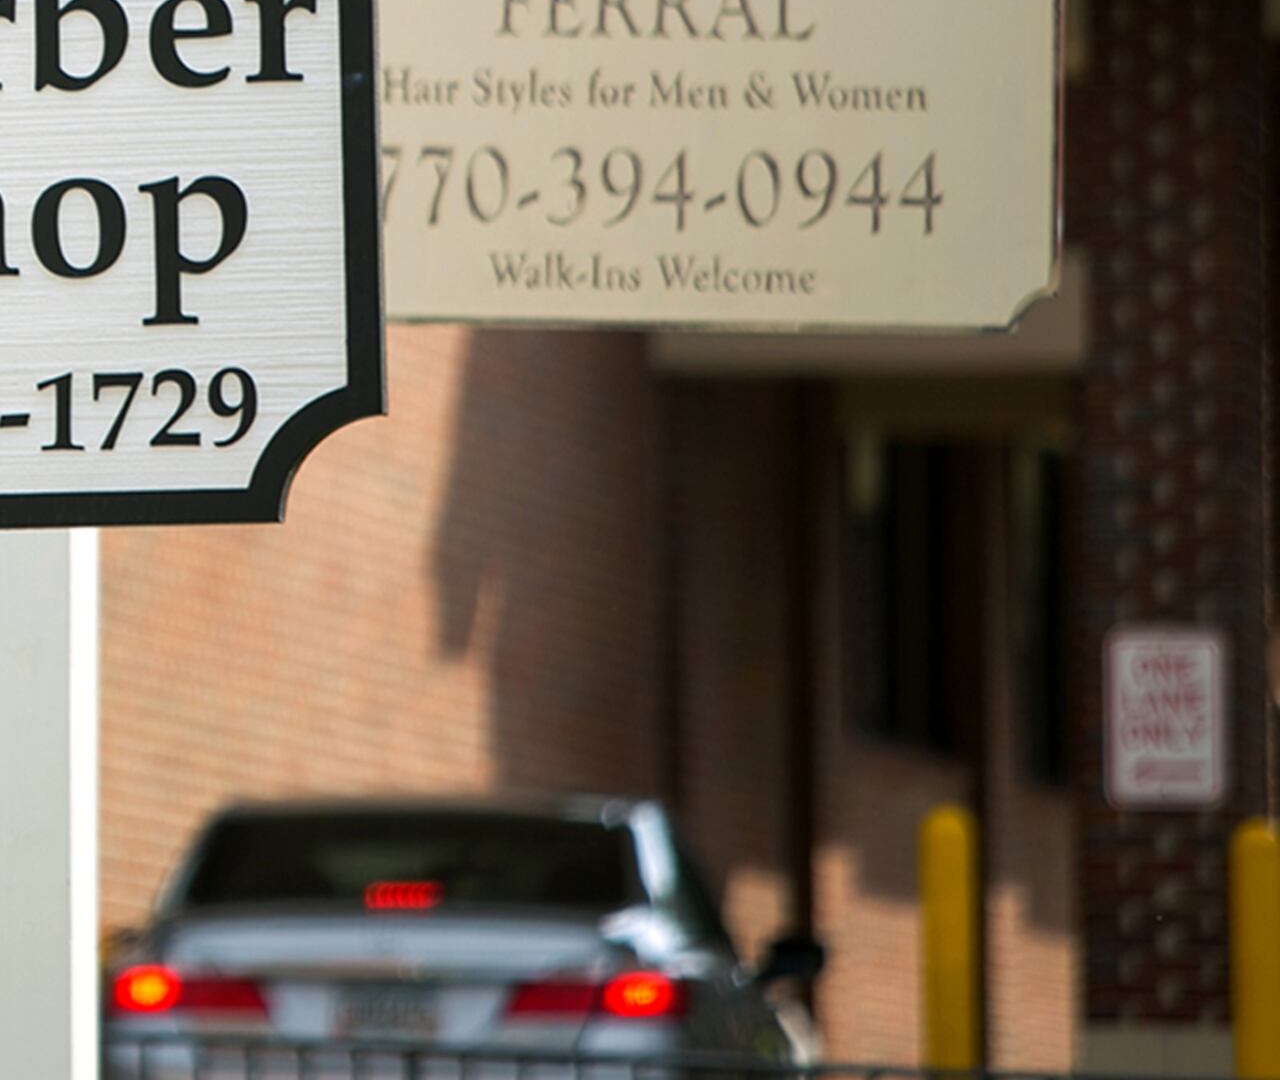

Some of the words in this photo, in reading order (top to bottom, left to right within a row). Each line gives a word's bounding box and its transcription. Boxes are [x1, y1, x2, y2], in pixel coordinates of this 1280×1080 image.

[382, 68, 458, 107] Hair
[471, 68, 572, 113] Styles
[586, 68, 637, 107] for
[648, 72, 729, 110] Men
[745, 73, 775, 110] &
[789, 70, 929, 113] Women
[380, 144, 944, 236] 770-394-0944
[488, 250, 642, 294] Walk-Ins
[658, 252, 818, 296] Welcome
